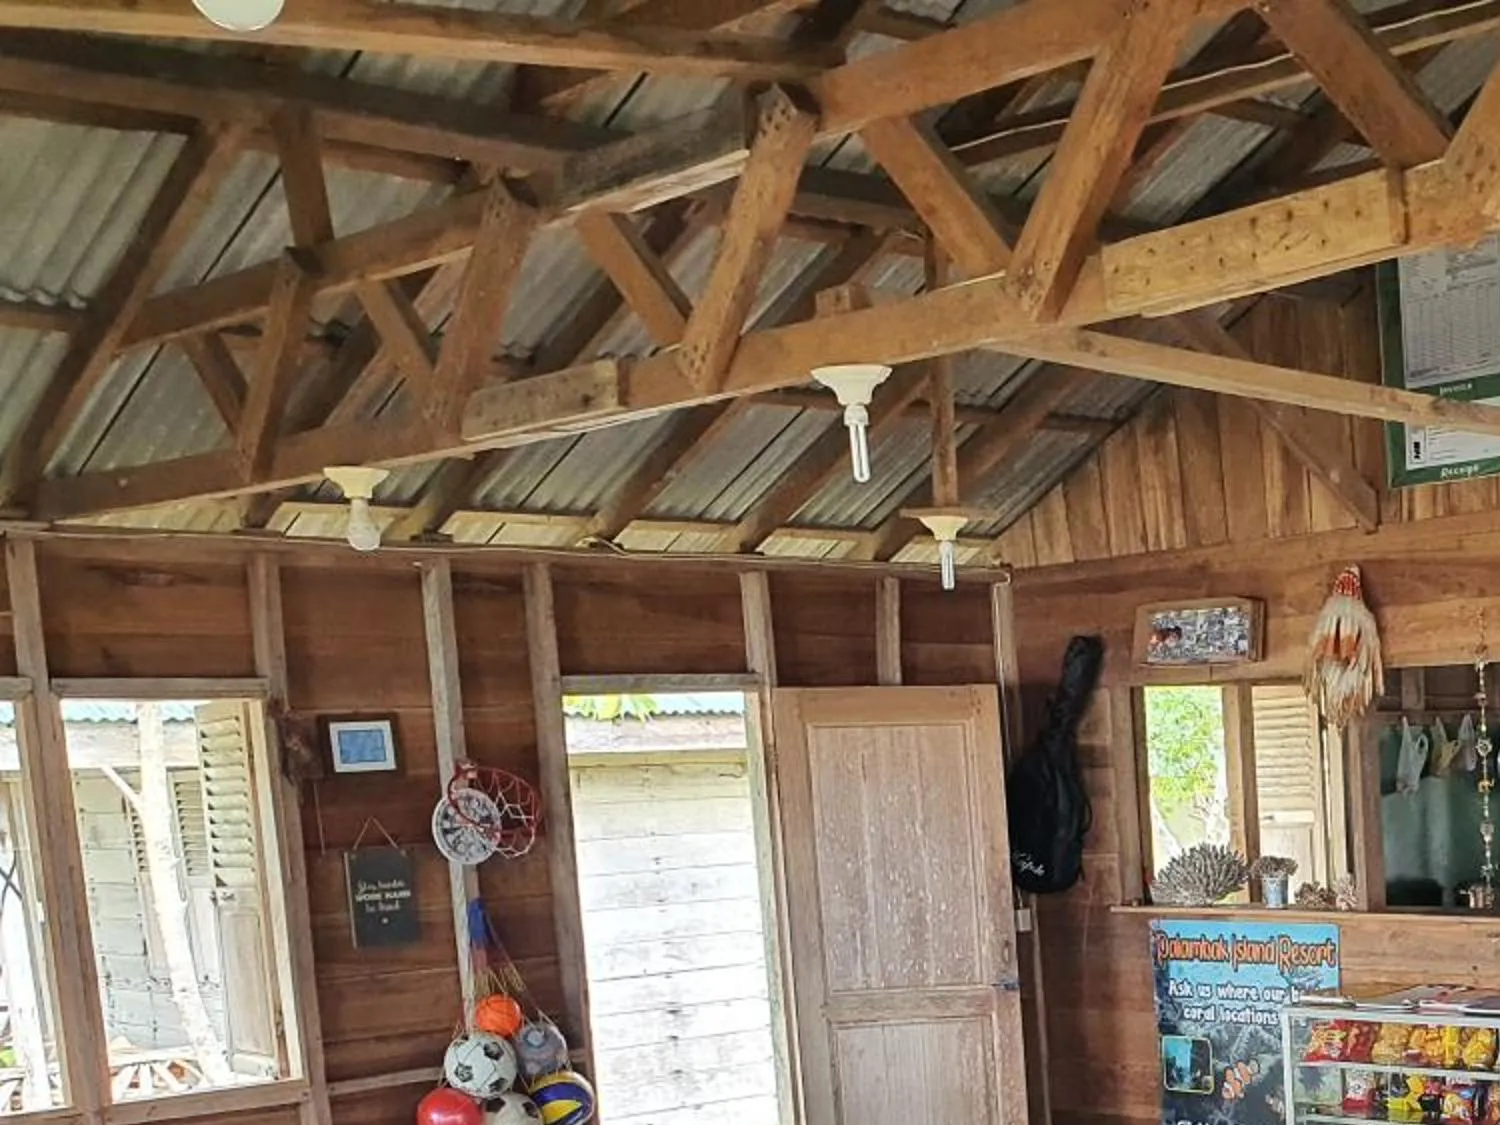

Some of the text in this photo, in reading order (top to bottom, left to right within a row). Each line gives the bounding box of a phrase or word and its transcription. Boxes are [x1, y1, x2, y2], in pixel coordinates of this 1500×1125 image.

[1231, 932, 1276, 972] Island
[1277, 934, 1337, 974] Resort
[1168, 979, 1193, 999] Ask
[1198, 984, 1211, 999] us
[1218, 981, 1259, 1001] where
[1264, 986, 1288, 1002] our
[1184, 1006, 1280, 1026] coral locations
